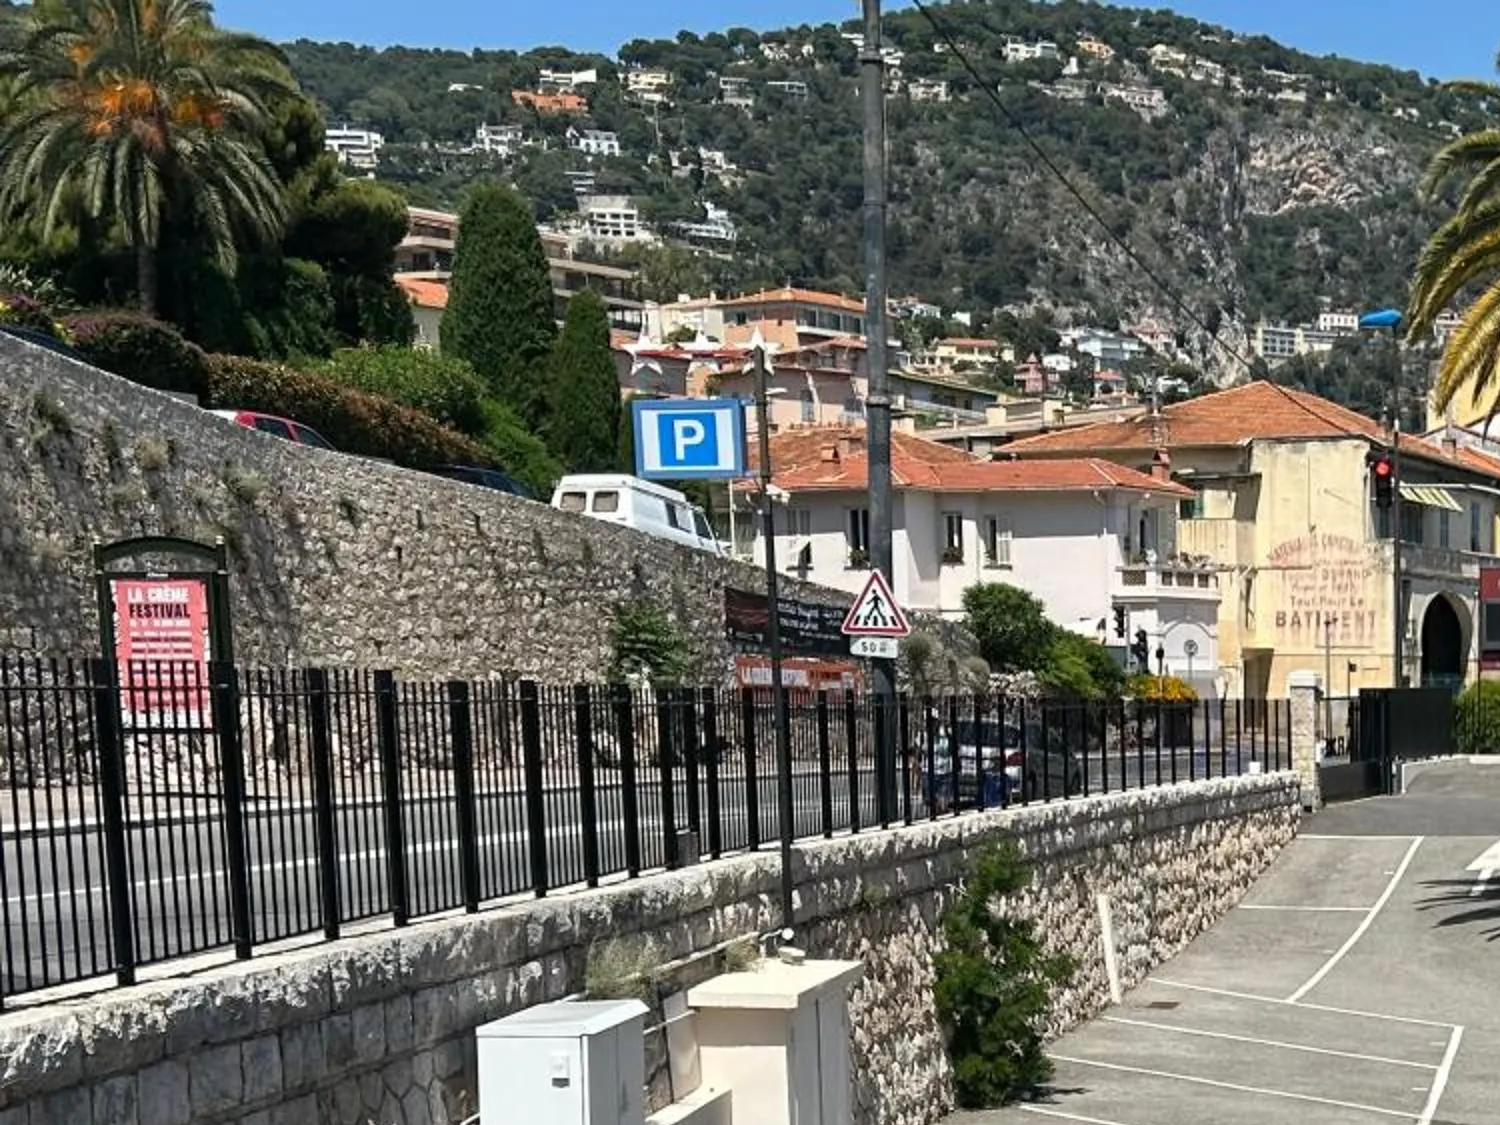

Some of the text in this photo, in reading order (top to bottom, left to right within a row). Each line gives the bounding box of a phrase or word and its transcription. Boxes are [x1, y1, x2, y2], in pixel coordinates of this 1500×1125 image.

[673, 418, 705, 461] P
[127, 586, 144, 602] LA
[129, 603, 191, 618] FESTIVAL
[1275, 610, 1376, 629] BATIMENT
[861, 641, 877, 653] 50
